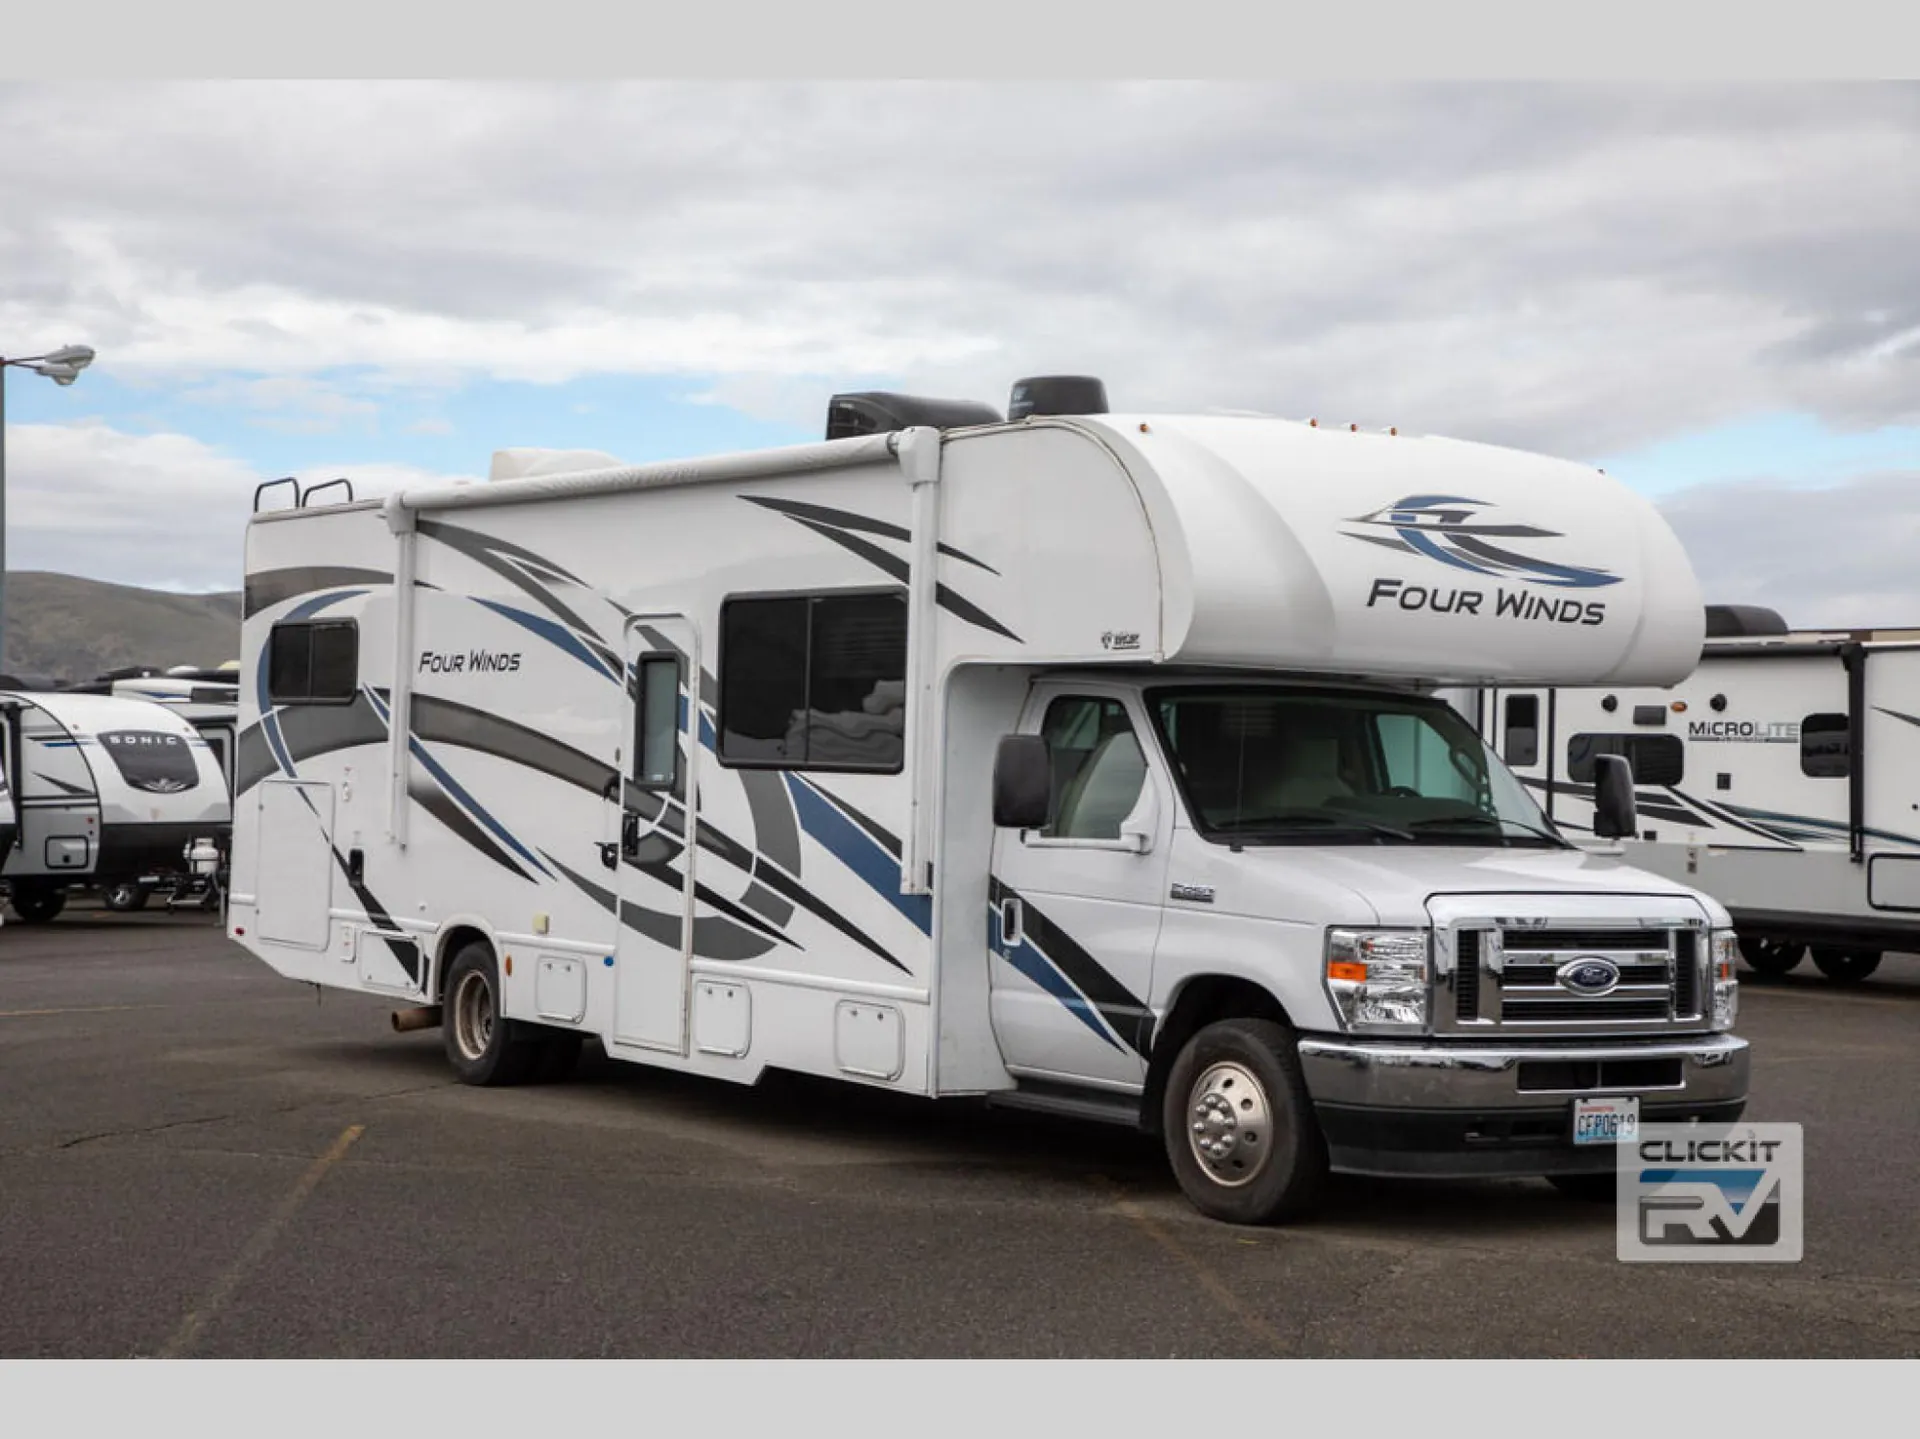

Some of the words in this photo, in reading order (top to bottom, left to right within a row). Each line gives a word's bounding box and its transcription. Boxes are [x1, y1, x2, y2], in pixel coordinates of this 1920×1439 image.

[1366, 578, 1484, 616] FOUR
[1495, 587, 1606, 626] WINDS
[418, 651, 465, 674] FOUR
[468, 648, 522, 672] WINDS
[109, 735, 177, 746] SONIC
